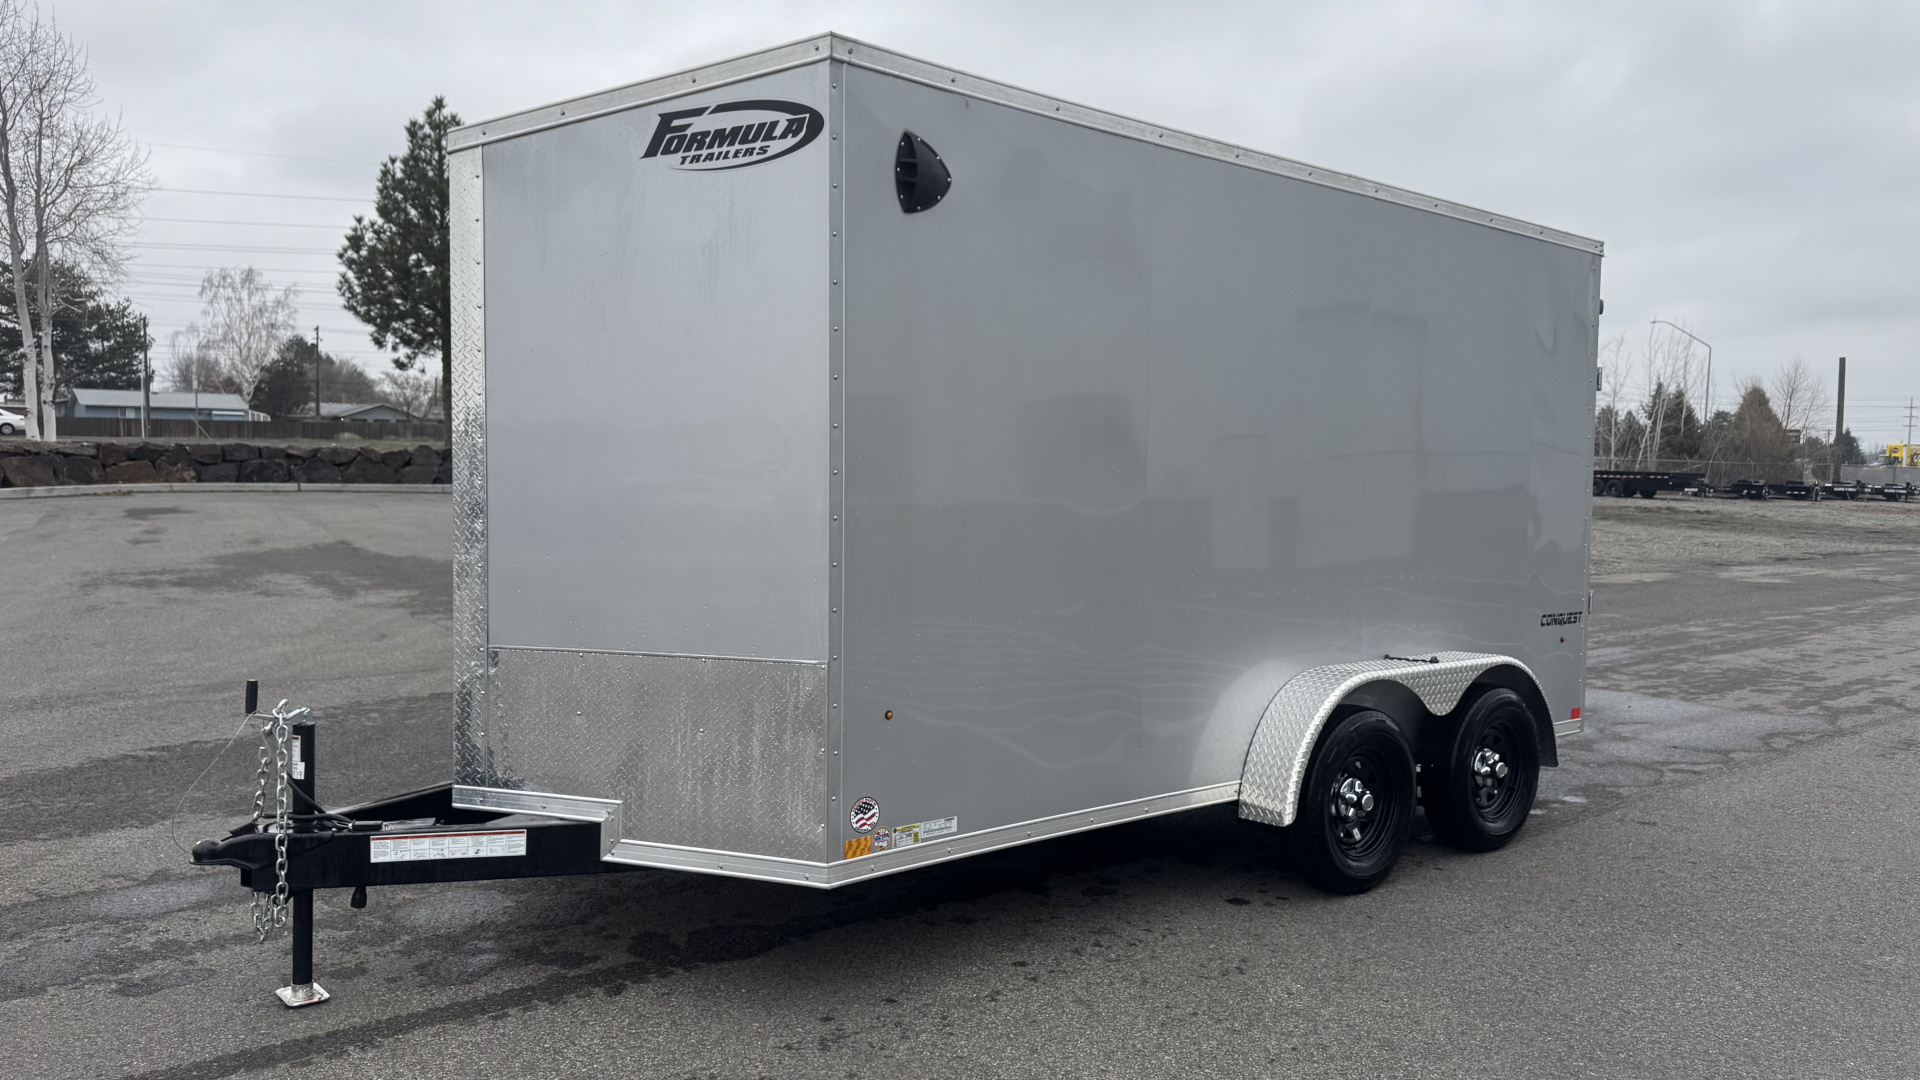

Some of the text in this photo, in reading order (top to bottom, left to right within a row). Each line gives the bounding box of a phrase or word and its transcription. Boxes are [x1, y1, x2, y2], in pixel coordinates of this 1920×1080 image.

[640, 106, 808, 159] FORMULA
[679, 145, 771, 166] TRAILERS
[1540, 611, 1583, 627] CONQUEST
